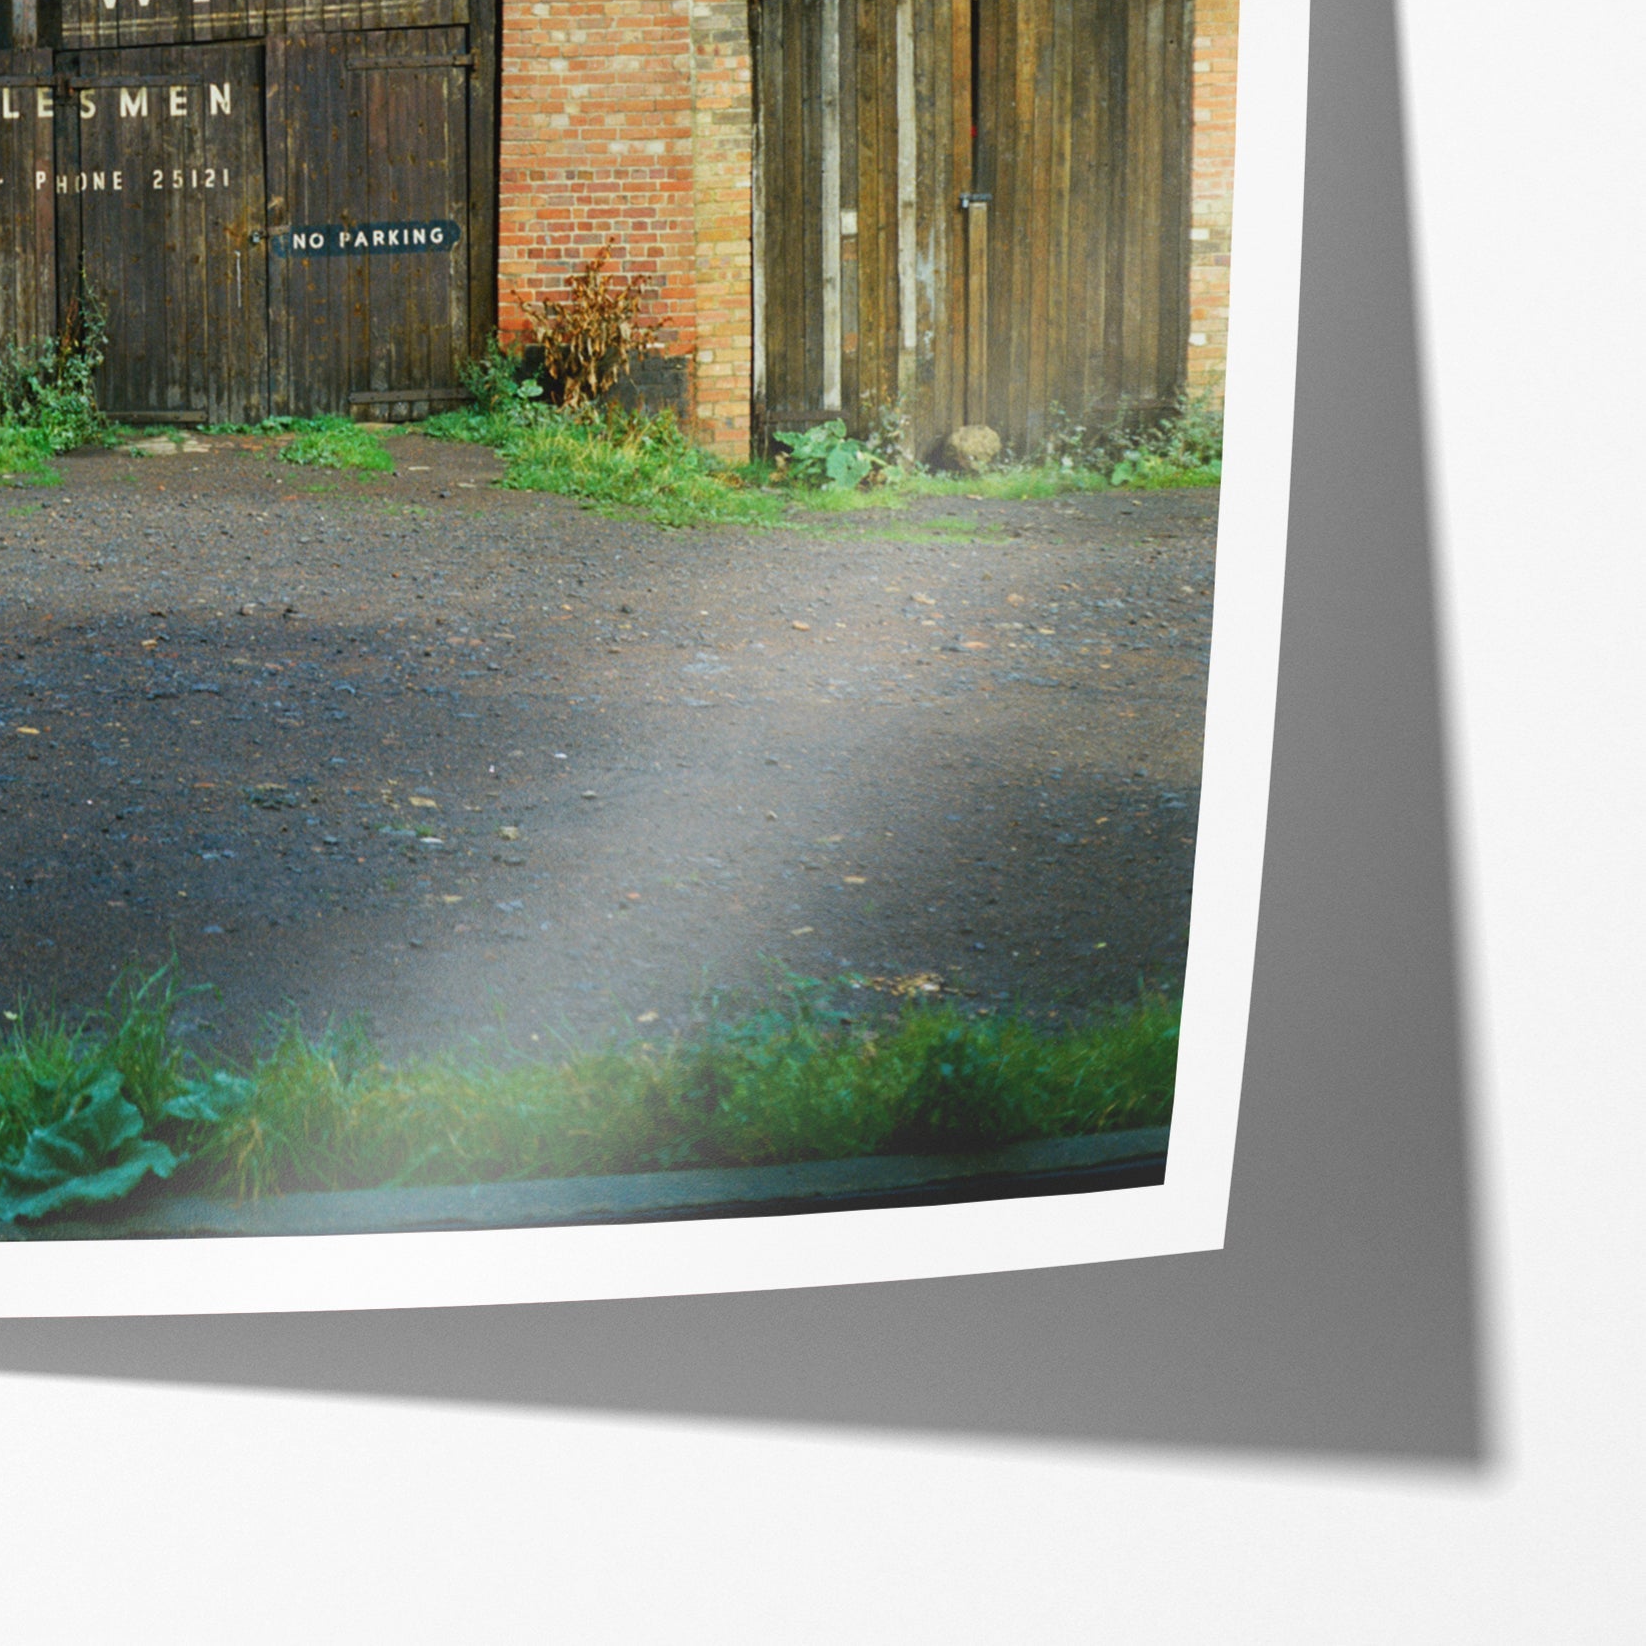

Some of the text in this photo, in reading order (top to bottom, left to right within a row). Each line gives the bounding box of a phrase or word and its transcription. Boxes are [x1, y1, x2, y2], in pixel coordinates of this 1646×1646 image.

[35, 170, 123, 194] PHONE
[153, 168, 229, 189] 25121
[292, 227, 444, 250] NO PARKING
